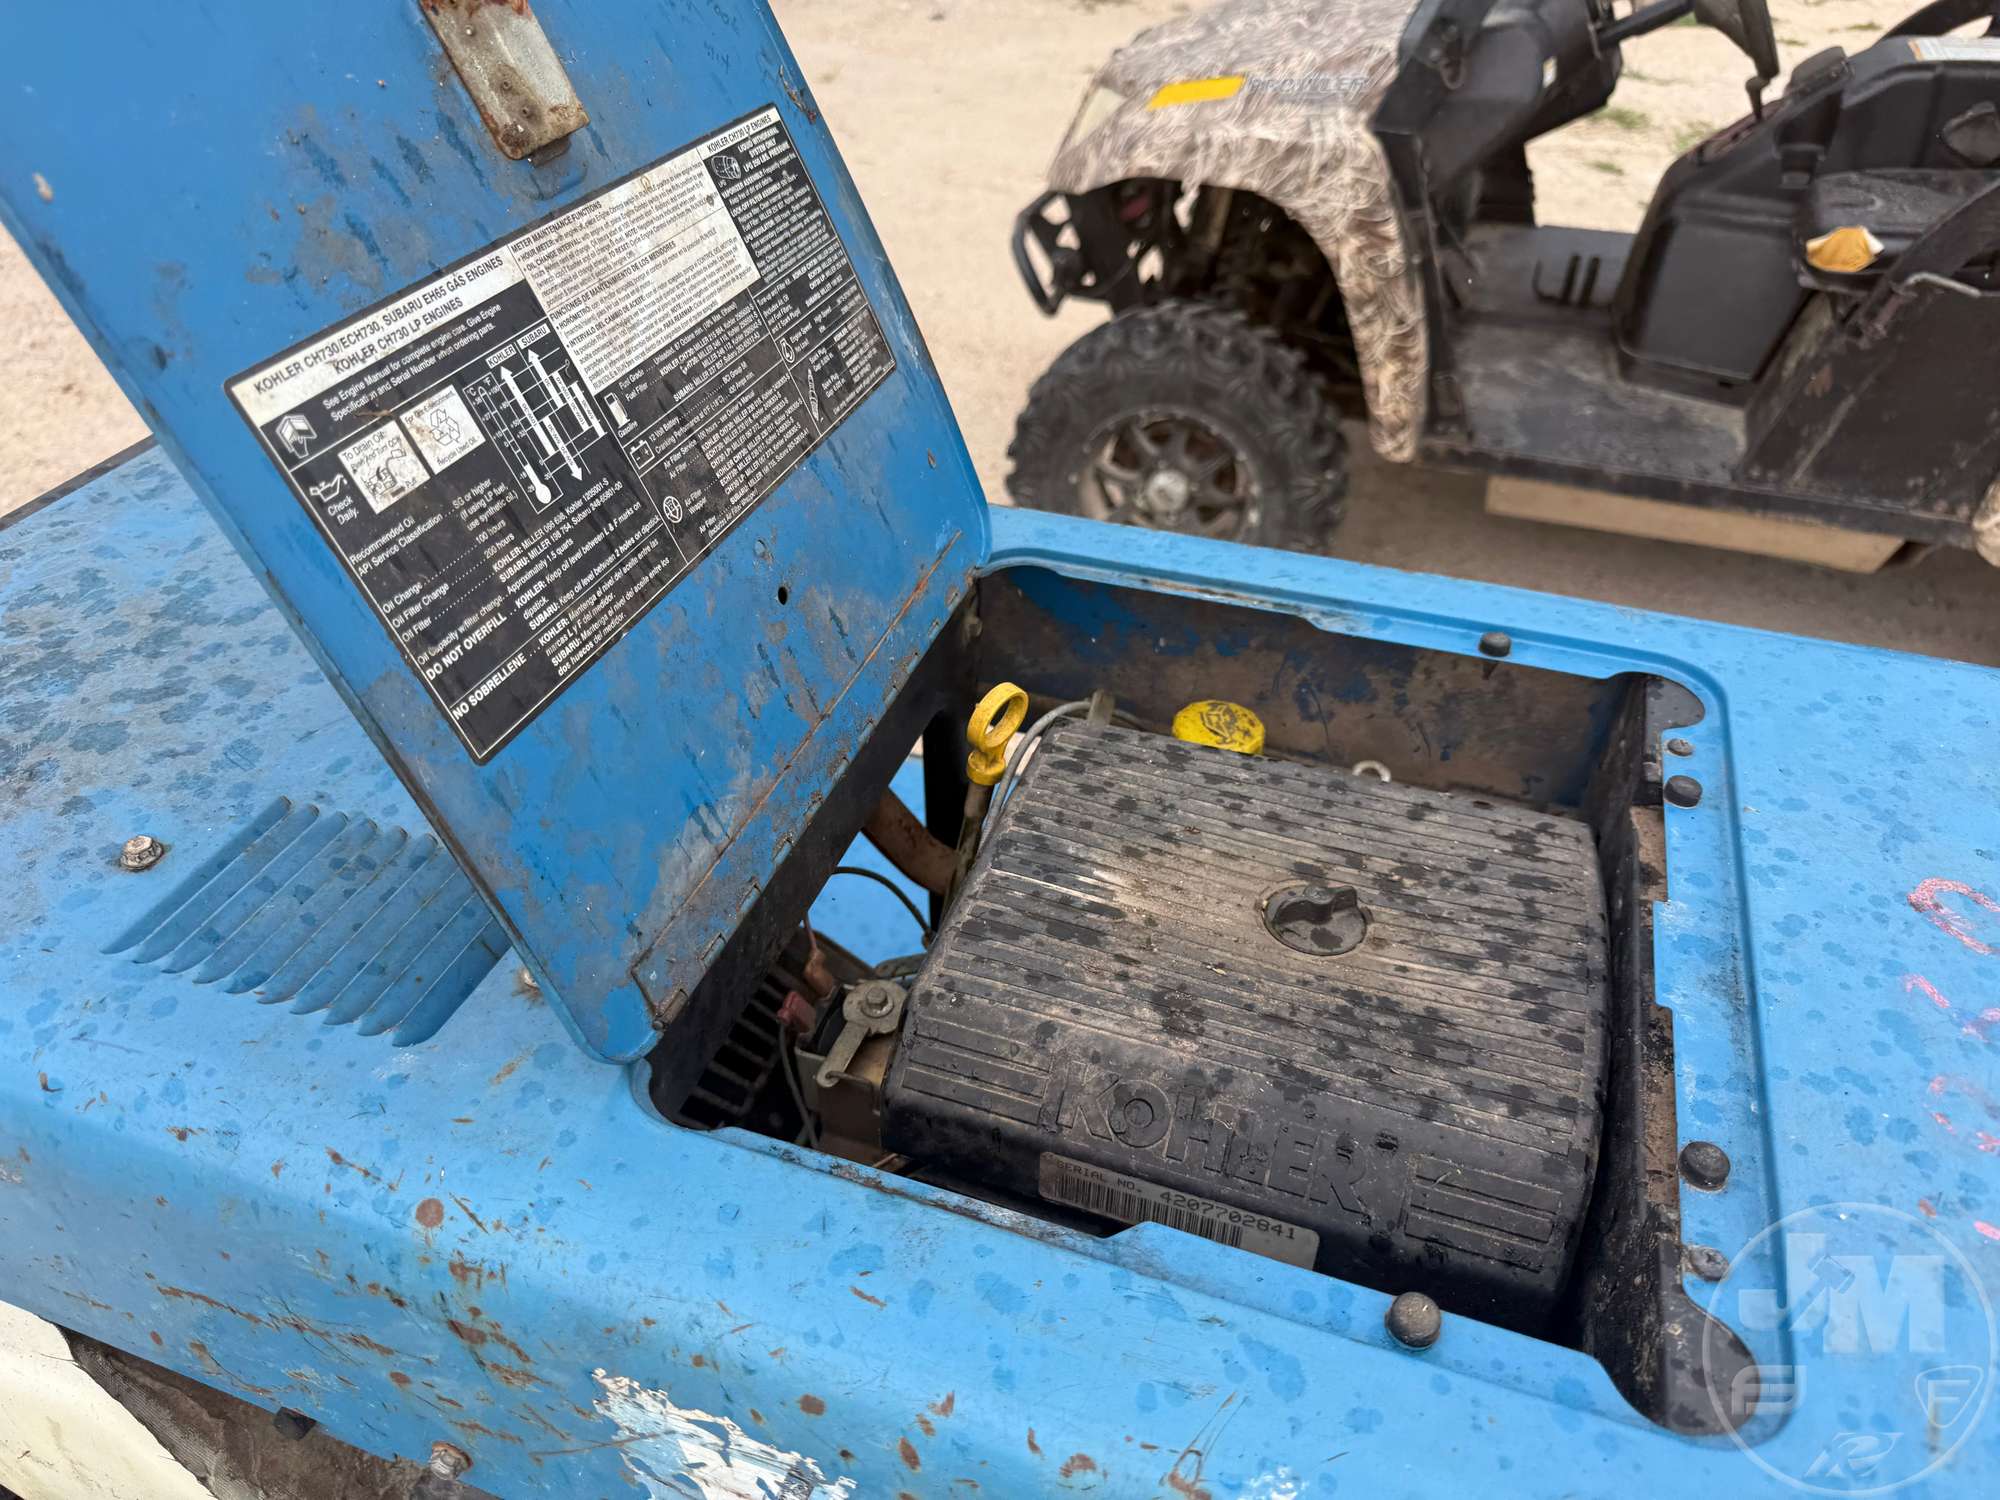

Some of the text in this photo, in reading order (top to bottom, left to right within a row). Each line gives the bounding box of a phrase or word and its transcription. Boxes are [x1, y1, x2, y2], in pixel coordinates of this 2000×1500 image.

[706, 136, 729, 153] KOHLER
[743, 124, 751, 134] LP
[750, 114, 771, 130] ENGINES
[510, 200, 602, 253] METER MAINTENANCE FUNCTIONS
[549, 297, 582, 321] FUNCIONES
[581, 292, 590, 302] DE
[630, 262, 640, 272] DE
[638, 256, 649, 267] LOS
[254, 255, 504, 395] KOHLER CH730/ECH730, SUBARU EH65 GAS ENGINES
[331, 296, 464, 375] KOHLER CH730 LP ENGINES
[520, 325, 547, 346] SUBARU
[322, 302, 503, 409] See Engine Manual for complete engine Give Engine
[375, 321, 496, 395] and Serial Number ordering parts.
[487, 345, 515, 367] KOHLER
[659, 357, 680, 376] KOHLER
[692, 370, 709, 386] MILLER
[342, 437, 374, 461] To Drain
[617, 419, 638, 438] Gasoline
[663, 415, 680, 432] Battery
[701, 432, 720, 452] KOHLER
[715, 458, 734, 478] KOHLER
[326, 494, 354, 516] Check
[336, 505, 361, 527] Daily.
[356, 477, 493, 577] API Service Classification SG or higher
[458, 481, 508, 520] (If using LP fuel,
[466, 497, 508, 531] use synthetic
[349, 515, 416, 565] Recommended Oil
[381, 517, 506, 614] Oil Change 100 hours
[498, 555, 530, 583] SUBARU:
[527, 537, 551, 560] MILLER
[571, 505, 591, 525] Subaru
[515, 578, 547, 609] KOHLER:
[544, 566, 563, 586] Keep
[560, 559, 570, 571] oil
[568, 548, 583, 564] level
[580, 530, 605, 554] between
[602, 526, 609, 535] L
[612, 518, 619, 527] F
[616, 505, 634, 524] marks
[632, 500, 641, 511] on
[391, 531, 515, 629] Oil Filter Change 200 hours
[400, 628, 414, 643] Oil
[412, 614, 432, 634] Filter
[492, 544, 523, 573] KOHLER:
[521, 527, 545, 550] MILLER
[565, 497, 583, 515] Kohler
[528, 530, 642, 631] SUBARU: Keep oil level between 2 holes on
[538, 537, 658, 647] KOHLER: Mantenga el nivel del aceite entre las
[416, 536, 574, 666] Oil Approximately 1.5 quarts
[521, 593, 550, 621] dipstick.
[551, 563, 662, 667] SUBARU: Mantenga el nivel del entre
[566, 590, 616, 637] L y F del medidor.
[424, 608, 507, 681] DO NOT OVERFILL
[557, 631, 603, 677] dos huecos del
[451, 650, 527, 721] NO SOBRELLENE
[1056, 1062, 1369, 1217] KOHLER
[1056, 1159, 1297, 1241] SERIAL NO. 4207702841
